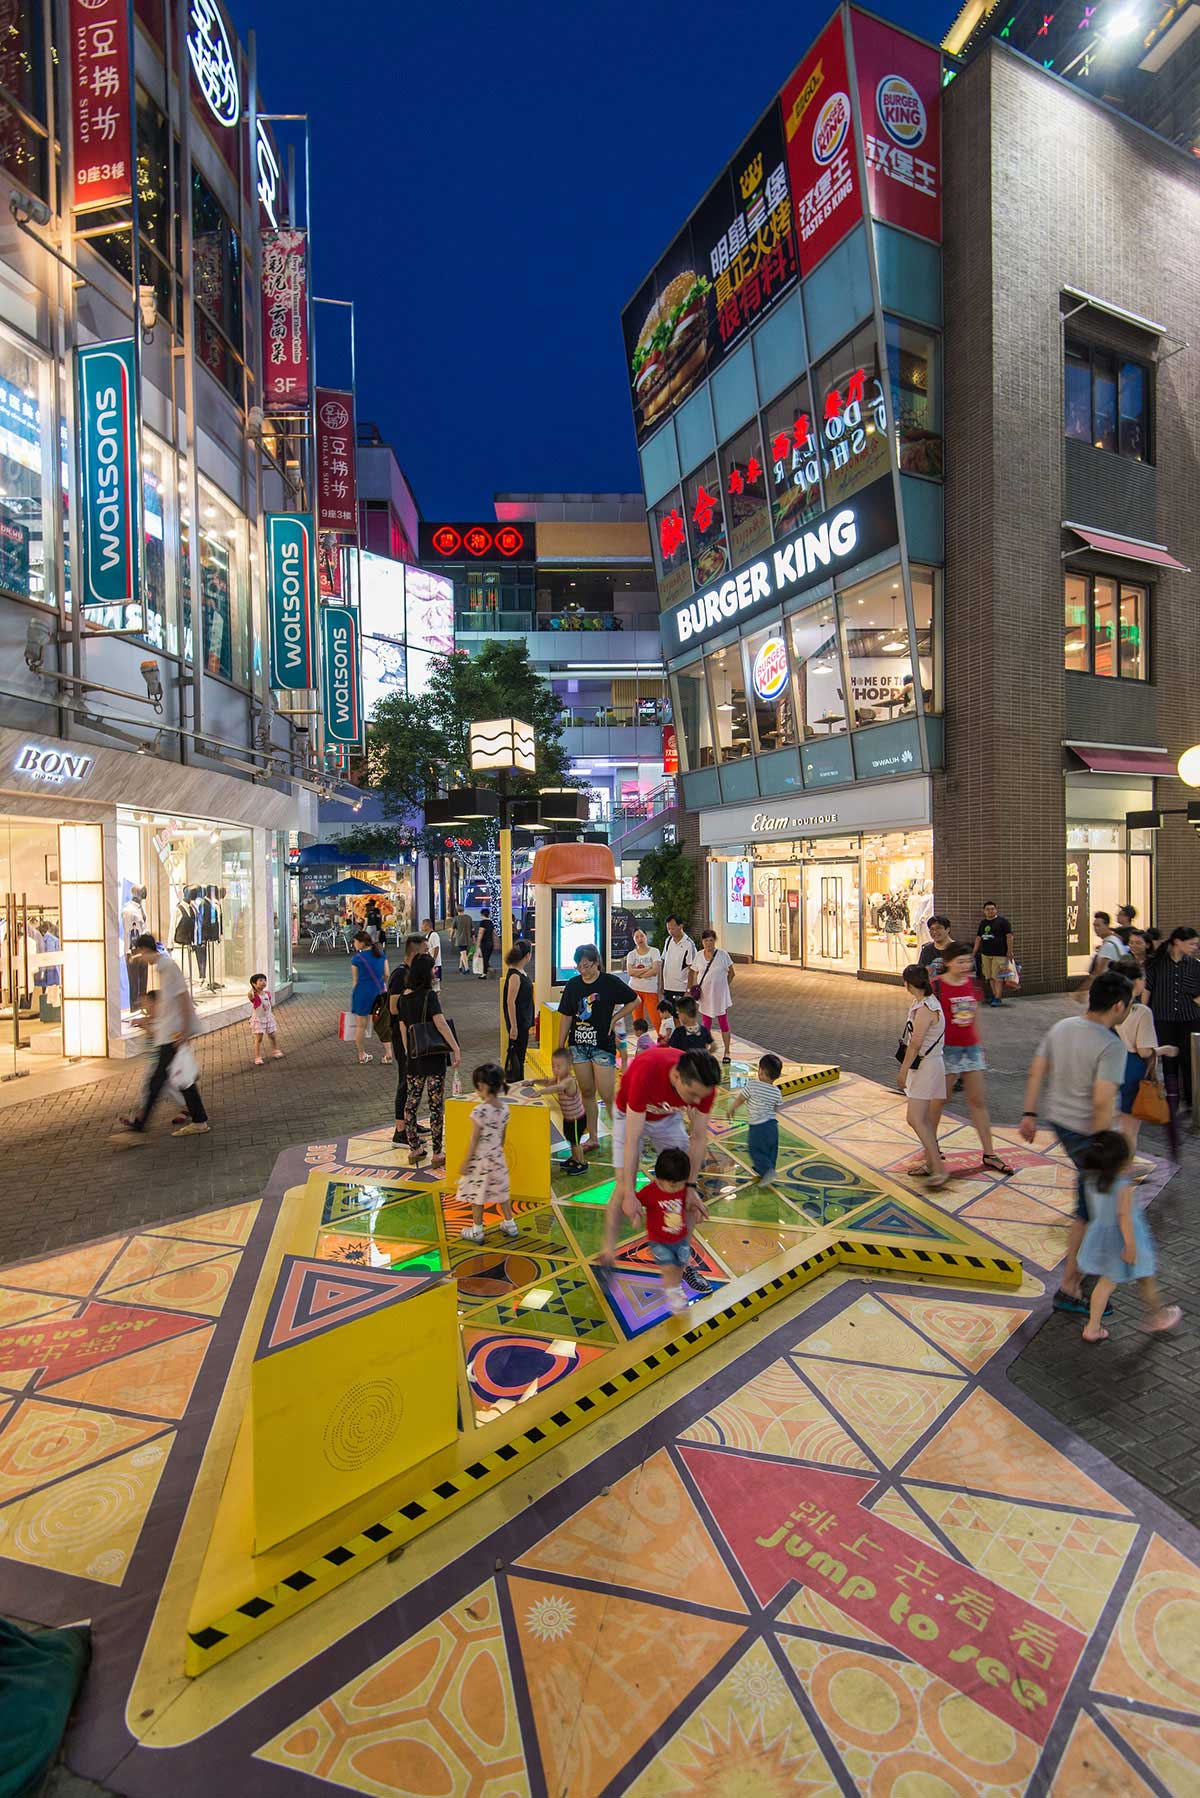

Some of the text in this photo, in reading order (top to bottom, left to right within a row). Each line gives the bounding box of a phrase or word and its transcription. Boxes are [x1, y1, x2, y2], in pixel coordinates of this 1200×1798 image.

[77, 26, 90, 144] DOLAR SHOP
[883, 94, 919, 109] BURGER
[819, 108, 846, 159] KING
[886, 107, 921, 125] KING
[799, 148, 851, 227] 汉堡王
[865, 134, 937, 198] 汉堡王
[801, 178, 853, 242] TASTE IS KING
[274, 378, 297, 393] 3F
[96, 387, 120, 572] watsons
[321, 434, 330, 497] DOLAR SHOP
[677, 561, 770, 642] BURGER
[774, 509, 858, 591] KING
[285, 542, 300, 669] watsons
[336, 627, 348, 724] watsons
[757, 645, 786, 678] BURGER
[759, 655, 787, 691] KING
[880, 676, 893, 686] OF
[19, 747, 93, 778] BONI
[751, 813, 838, 832] Etam BOUTIQUE
[730, 892, 743, 902] SAL
[574, 1030, 598, 1040] FROOT
[789, 1500, 1060, 1671] 跳上去看看
[755, 1520, 1048, 1712] jump to see
